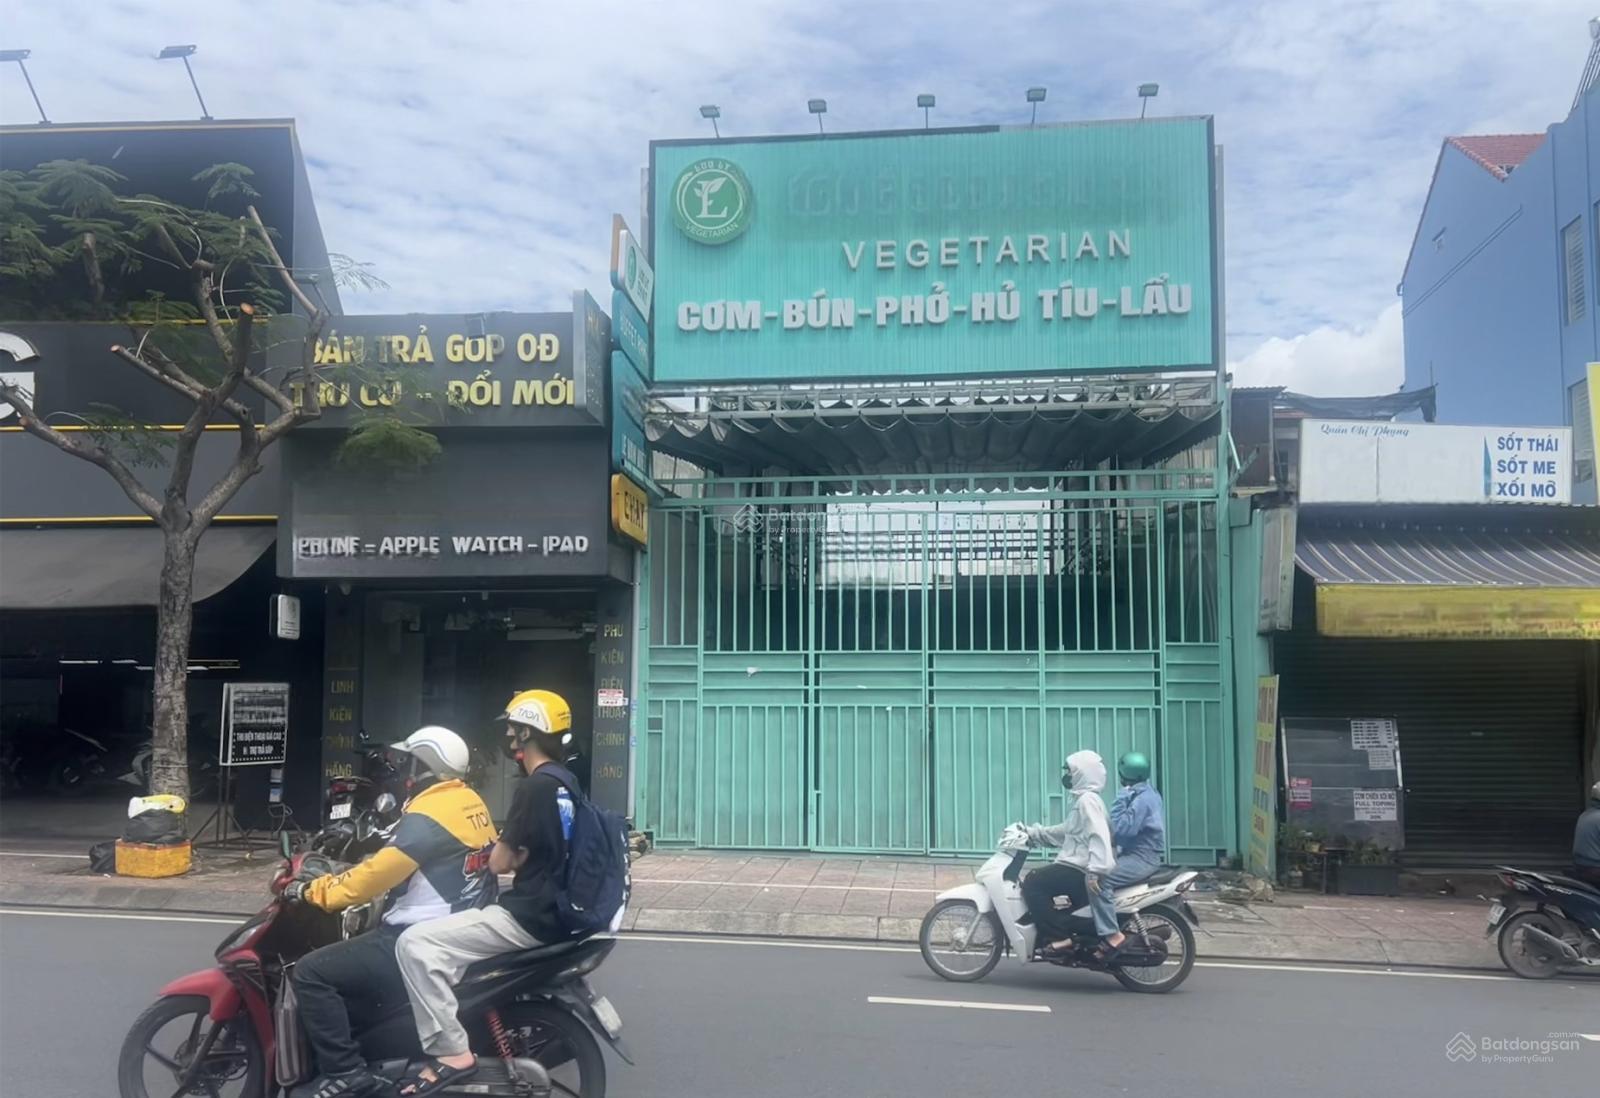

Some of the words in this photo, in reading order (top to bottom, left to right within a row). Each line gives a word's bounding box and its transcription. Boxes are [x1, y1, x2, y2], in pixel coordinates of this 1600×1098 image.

[842, 229, 1131, 269] VEGETARIAN
[512, 373, 575, 406] MỚI
[1497, 432, 1523, 451] SỐT
[1527, 434, 1558, 452] THÁI
[1497, 454, 1528, 474] SỐT
[1533, 461, 1556, 474] ME
[1497, 477, 1525, 496] XỐI
[380, 536, 440, 553] APPLE
[452, 536, 523, 552] WATCH
[543, 536, 588, 555] IPAD
